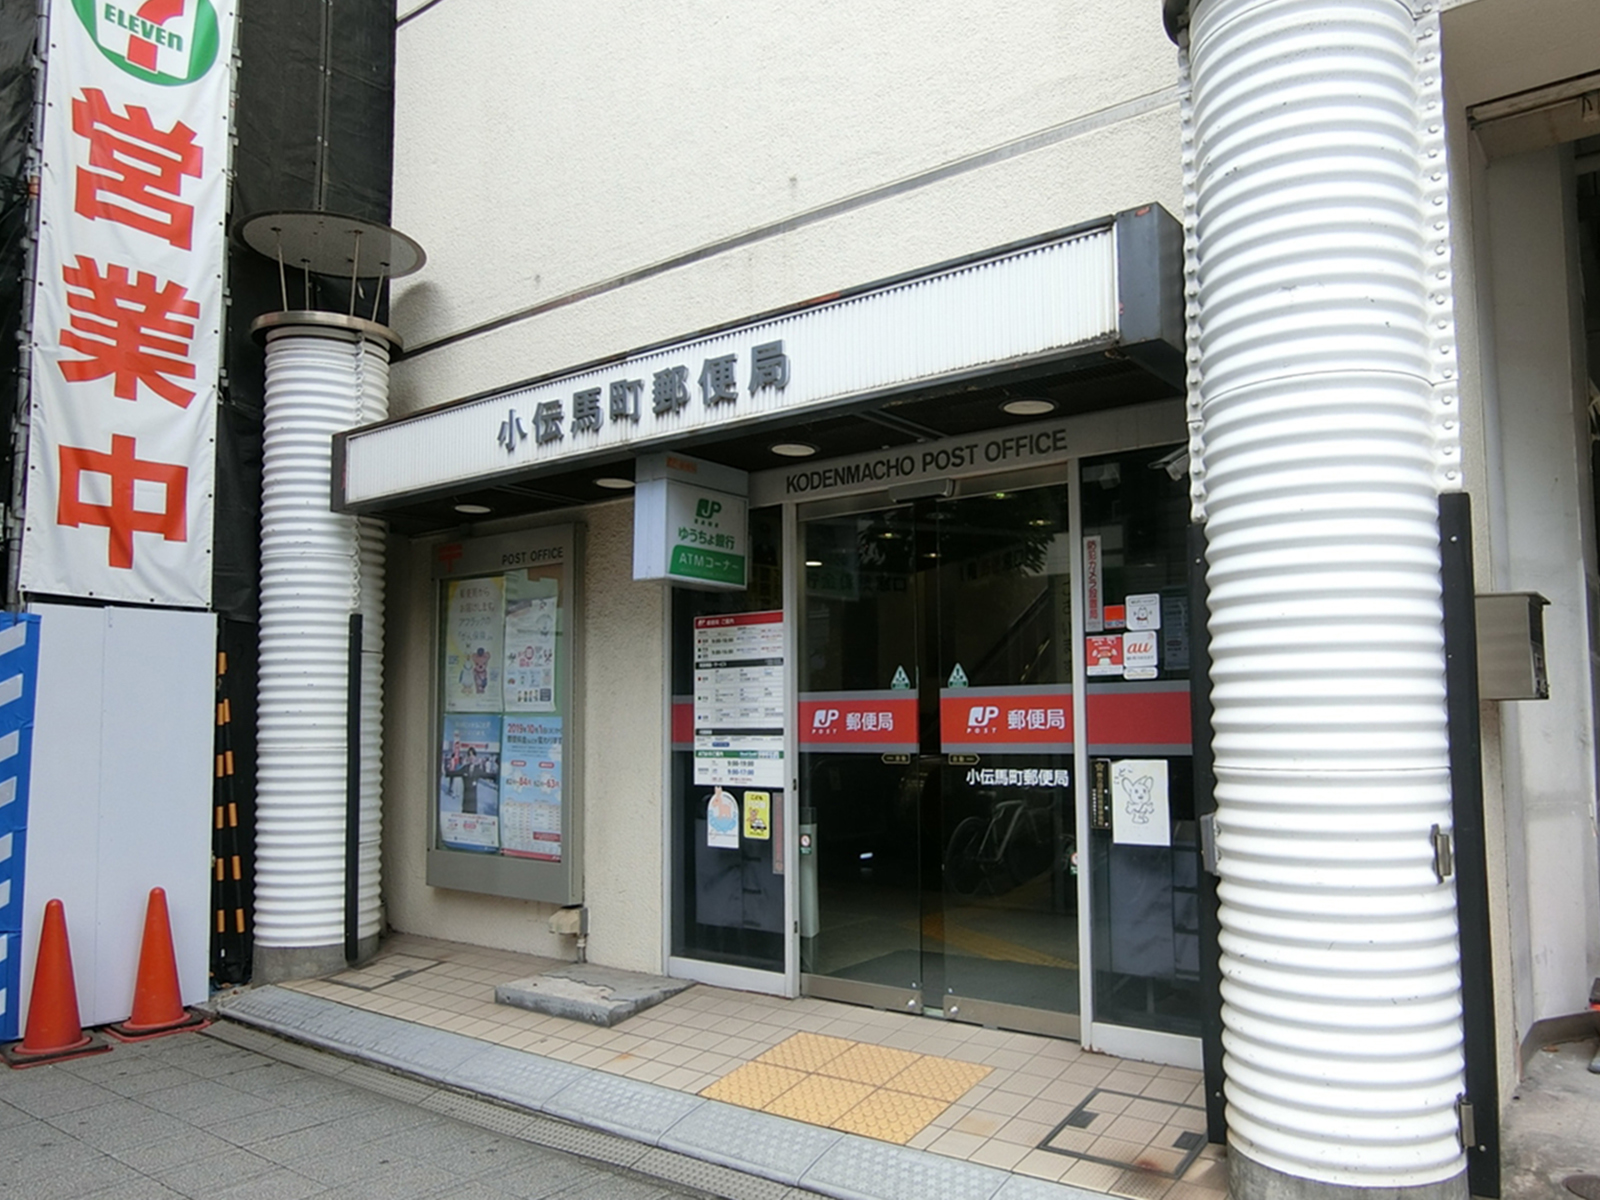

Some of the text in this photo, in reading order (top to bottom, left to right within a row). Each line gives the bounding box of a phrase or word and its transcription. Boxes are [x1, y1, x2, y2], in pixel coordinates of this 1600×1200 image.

[57, 87, 204, 570] 営業中
[497, 339, 791, 452] 小伝馬町郵便局
[786, 429, 1068, 494] KODENMACHO POST OFFICE
[695, 498, 722, 519] JP
[678, 527, 735, 550] ゆうちょ銀行
[501, 546, 564, 566] POST OFFICE
[679, 553, 740, 571] ATMコーナー
[1127, 642, 1152, 655] au
[813, 709, 839, 728] JP
[846, 712, 894, 731] 郵便局
[967, 706, 999, 728] JP
[1007, 709, 1066, 730] 郵便局
[966, 768, 1069, 787] 小伝馬町郵便局
